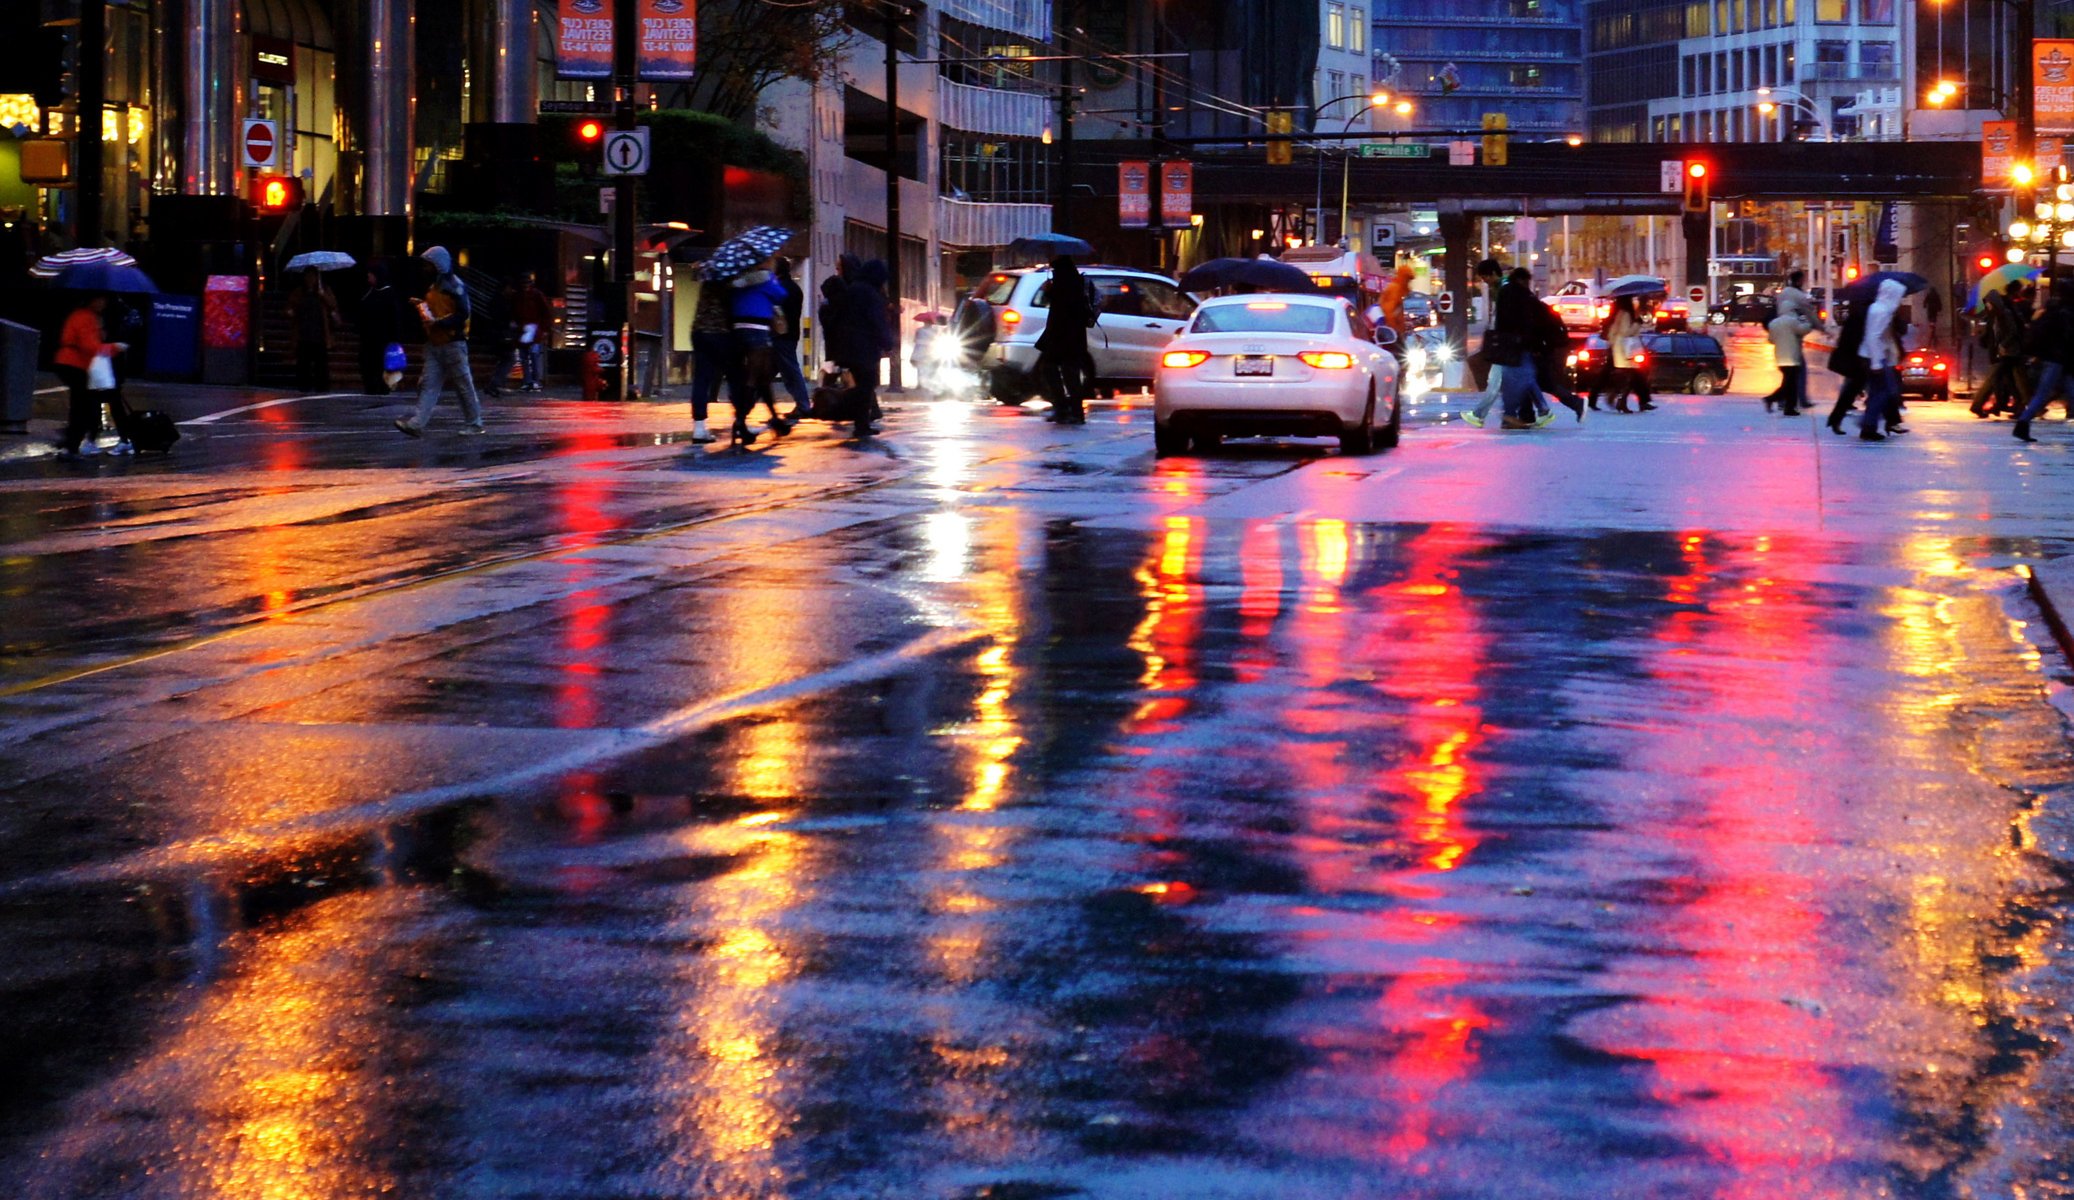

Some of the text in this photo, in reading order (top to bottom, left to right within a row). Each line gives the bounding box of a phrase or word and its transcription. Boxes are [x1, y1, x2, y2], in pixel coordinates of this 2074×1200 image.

[2035, 86, 2059, 94] GREY
[2035, 94, 2074, 103] FESTIVAL
[1377, 229, 1391, 242] P
